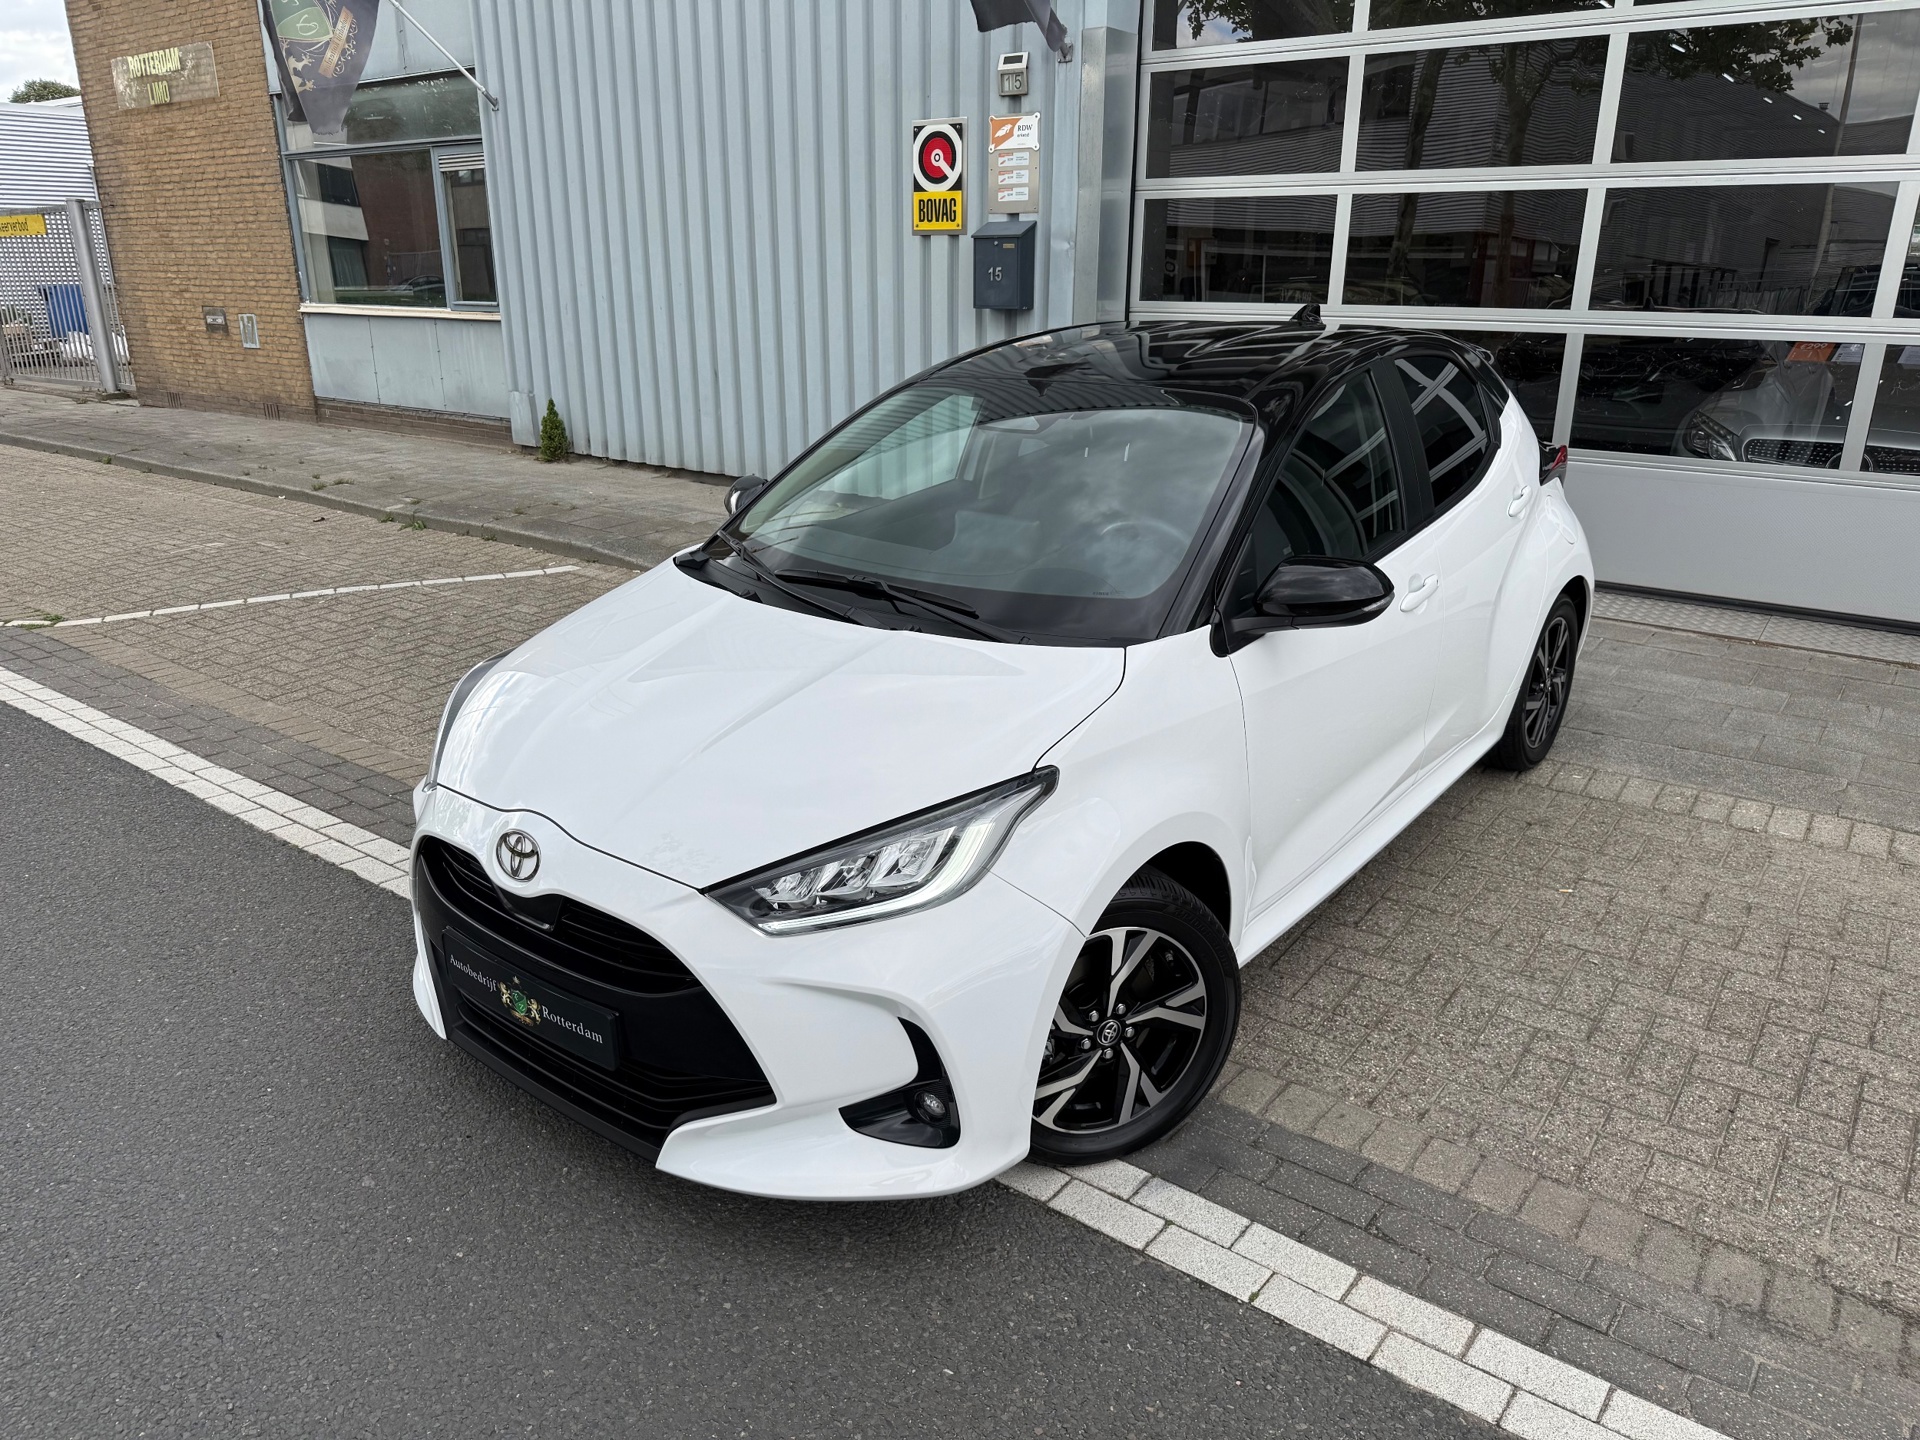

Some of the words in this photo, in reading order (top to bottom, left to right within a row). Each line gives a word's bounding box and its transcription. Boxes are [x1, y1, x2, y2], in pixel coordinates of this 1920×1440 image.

[127, 47, 181, 79] ROTTERDAM
[1005, 74, 1022, 90] 15
[147, 81, 170, 105] LIMO
[1017, 124, 1033, 132] RDW
[918, 197, 957, 223] BOVAG
[0, 217, 29, 232] eerverbod
[988, 266, 1002, 282] 15
[450, 954, 498, 992] Autobedrijf
[541, 1004, 603, 1044] Rotterdam
